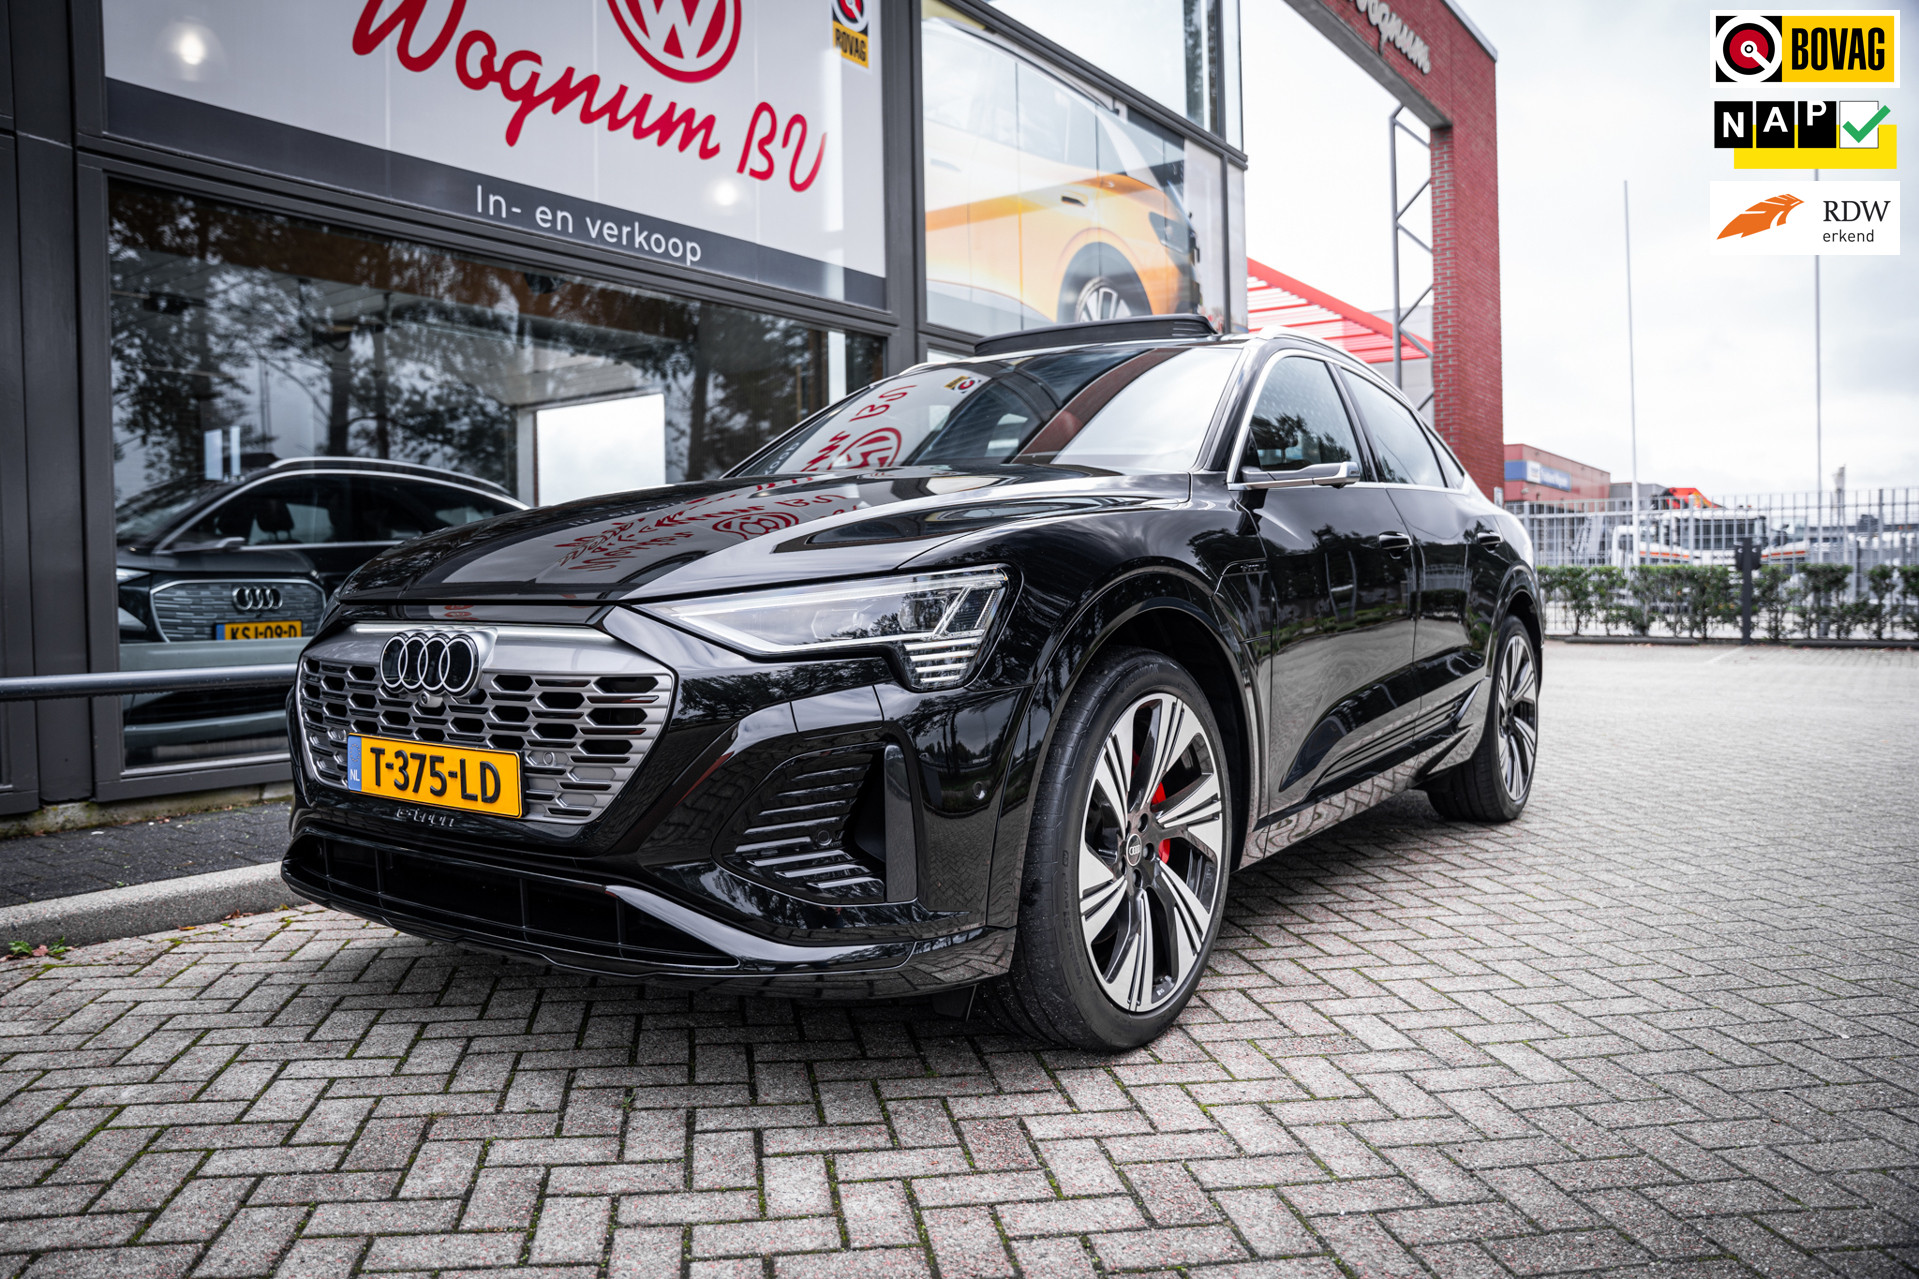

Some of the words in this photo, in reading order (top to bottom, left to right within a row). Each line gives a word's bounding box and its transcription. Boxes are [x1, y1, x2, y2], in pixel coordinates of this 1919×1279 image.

[352, 0, 720, 160] Wognum
[736, 101, 827, 192] BV
[476, 184, 521, 218] In-
[535, 205, 573, 233] en
[585, 216, 702, 266] verkoop
[350, 768, 361, 782] NL
[370, 746, 501, 804] T-375-LD
